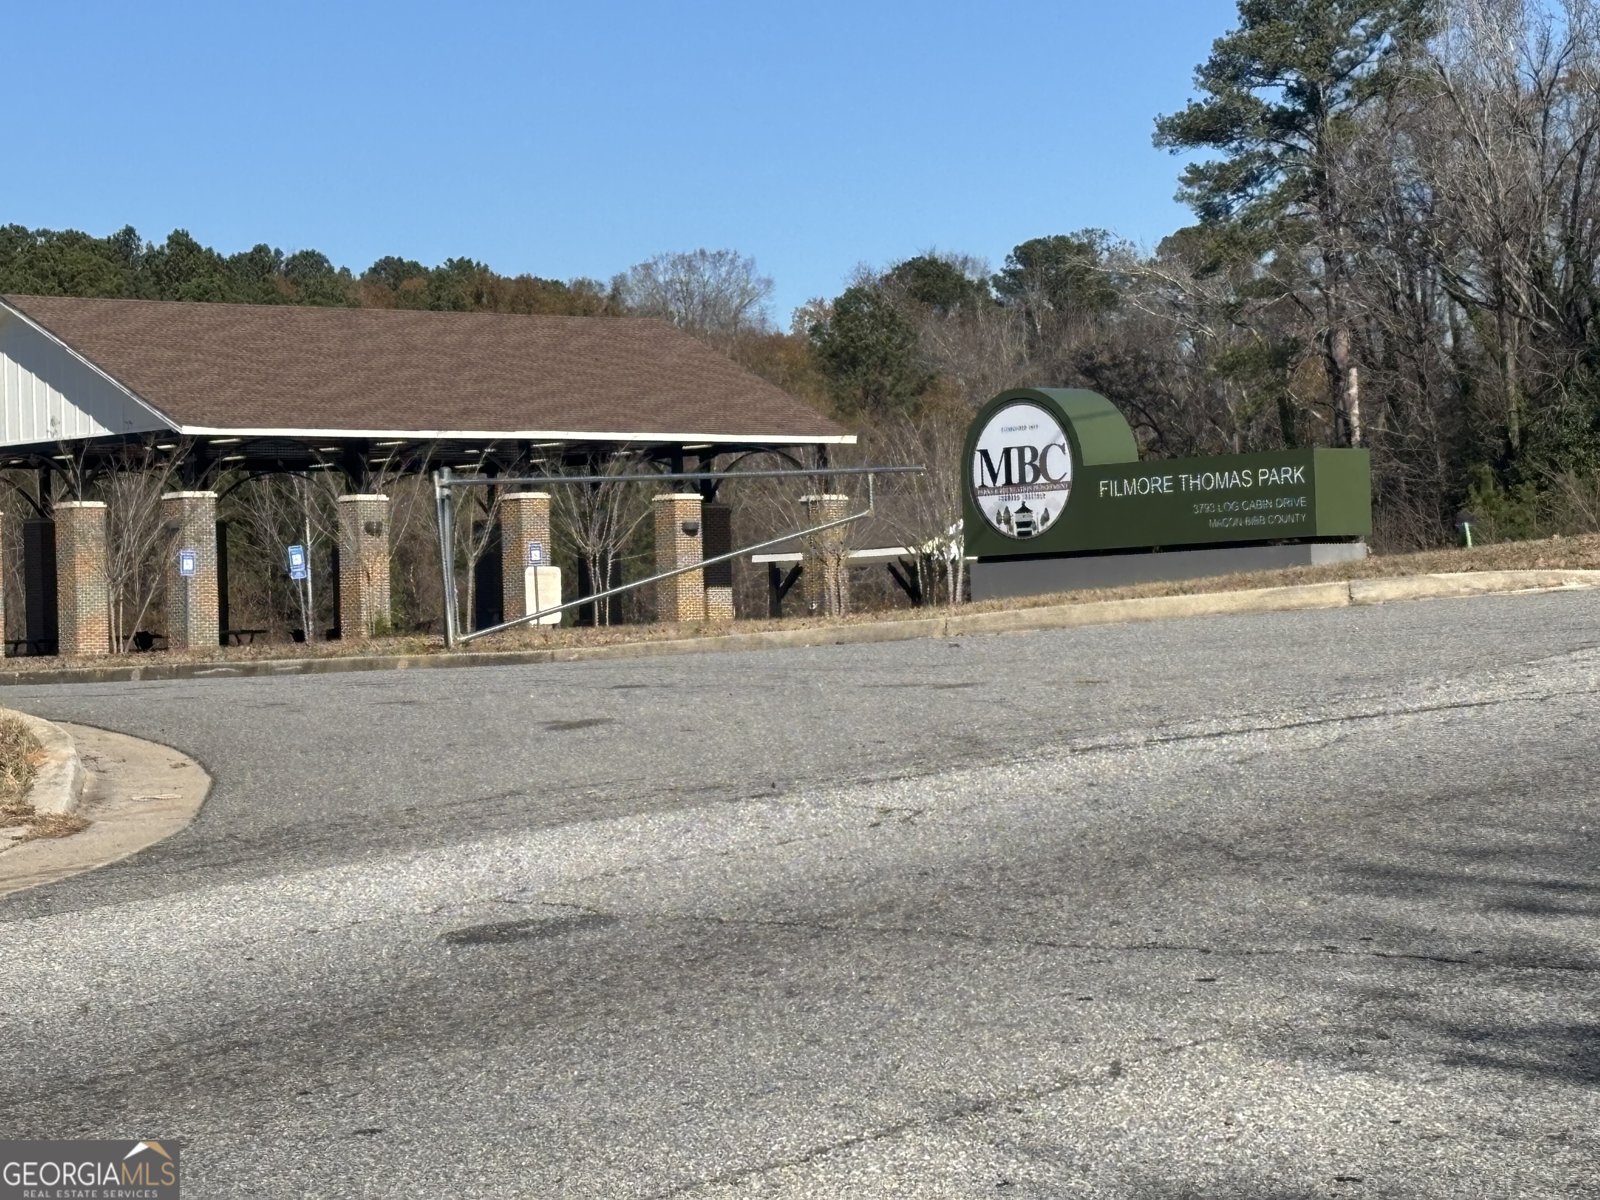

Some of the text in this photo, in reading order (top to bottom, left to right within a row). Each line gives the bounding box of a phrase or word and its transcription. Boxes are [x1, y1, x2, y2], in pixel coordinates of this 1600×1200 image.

[975, 442, 1067, 487] MBC
[1099, 465, 1306, 497] FILMORE THOMAS PARK
[1192, 496, 1307, 514] 3793 LOG CABIN DRIVE
[1267, 513, 1306, 525] COUNTY
